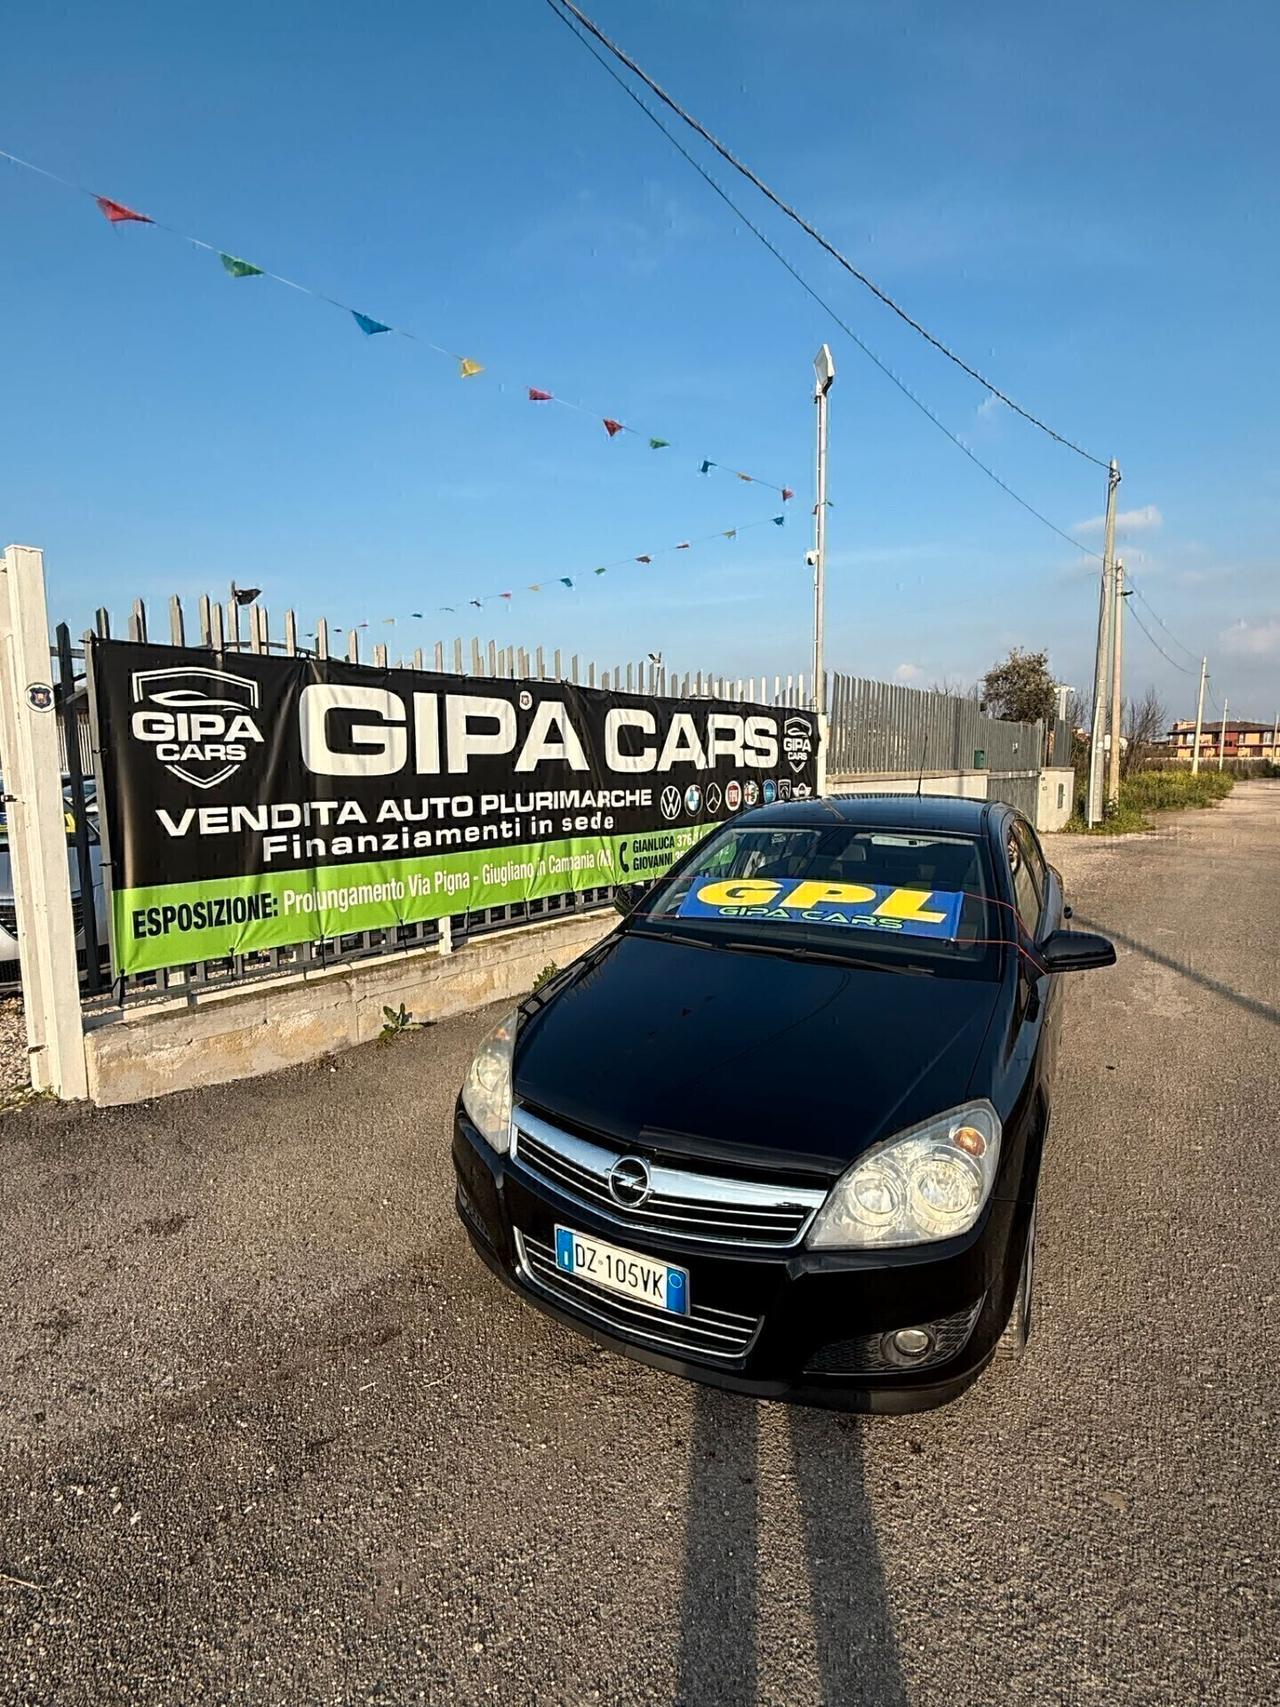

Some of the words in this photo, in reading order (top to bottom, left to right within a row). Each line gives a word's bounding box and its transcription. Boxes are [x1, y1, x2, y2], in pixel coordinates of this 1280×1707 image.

[131, 710, 264, 743] GIPA
[299, 683, 590, 775] GIPA
[604, 707, 778, 773] CARS
[155, 743, 247, 762] CARS
[783, 737, 812, 752] GIPA
[787, 752, 808, 761] CARS
[155, 800, 366, 837] VENDITA
[376, 794, 474, 824] AUTO
[480, 788, 652, 816] PLURIMARCHE
[263, 819, 521, 862] Finanziamenti
[531, 814, 553, 836] in
[561, 811, 615, 831] sede
[633, 835, 675, 854] GIANLUCA
[633, 851, 673, 870] GIOVANNI
[132, 892, 279, 940] ESPOSIZIONE:
[283, 876, 406, 914] Prolungamento
[409, 870, 432, 897] Via
[435, 869, 471, 897] Pigna
[482, 859, 535, 888] Giugliano
[548, 850, 595, 874] Campania
[696, 878, 948, 924] GPL
[718, 905, 793, 918] GIPA
[801, 910, 905, 930] CARS
[575, 1243, 598, 1274] DZ
[605, 1254, 664, 1300] 105VK
